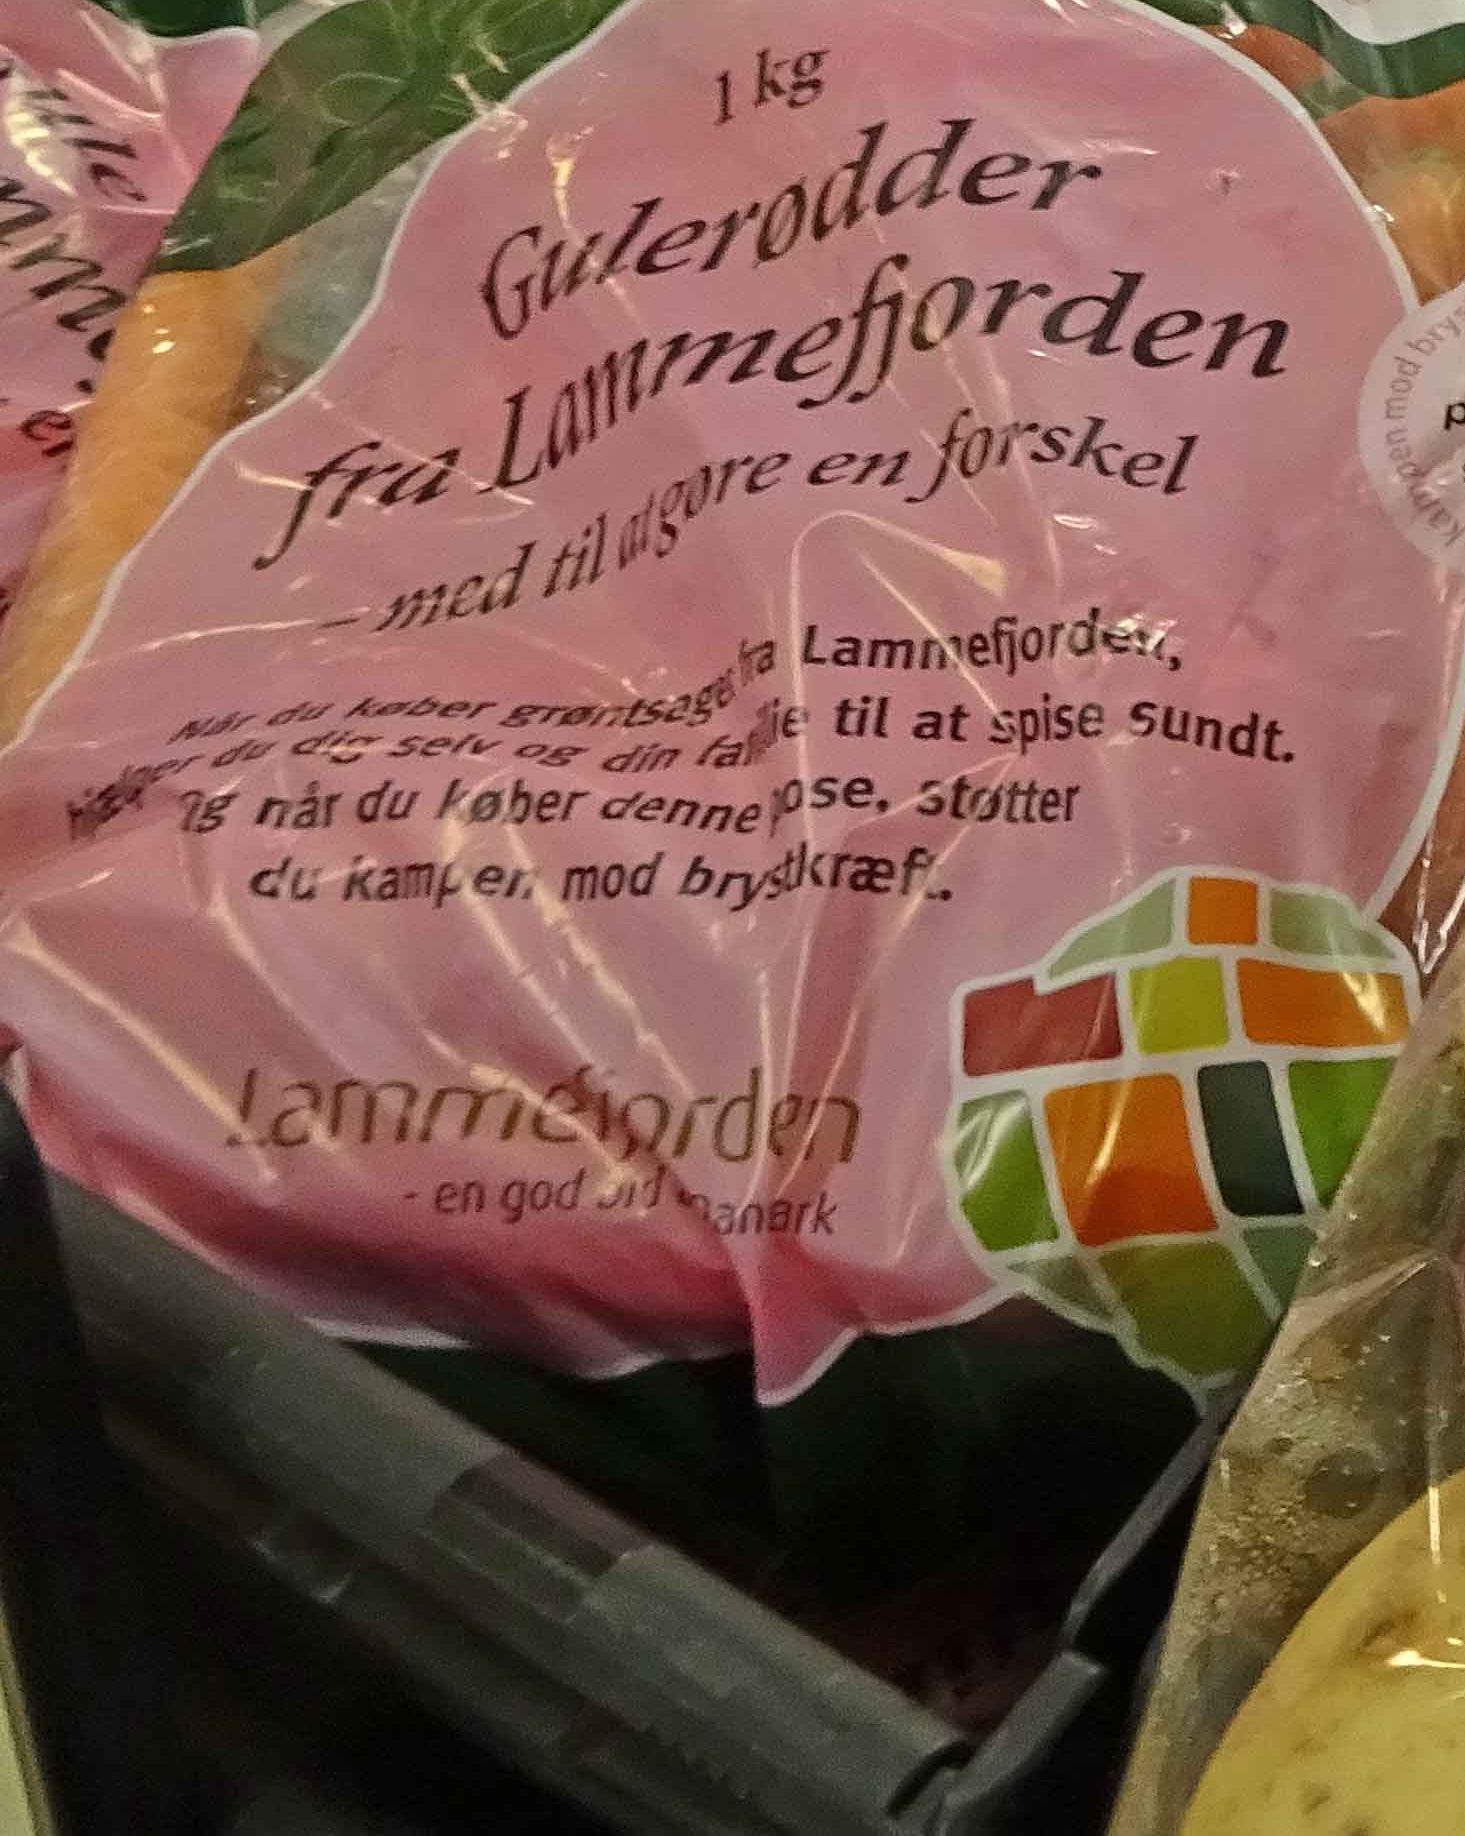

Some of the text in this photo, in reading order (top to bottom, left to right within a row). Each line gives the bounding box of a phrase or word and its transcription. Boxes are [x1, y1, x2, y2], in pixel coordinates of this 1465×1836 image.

[713, 46, 830, 126] 1 kg
[478, 117, 1104, 341] Gulerødder
[255, 253, 1291, 569] fra Lammefjorden
[371, 540, 551, 634] med
[542, 511, 609, 599] til
[806, 445, 914, 490] en
[904, 407, 1201, 506] forskel
[344, 693, 499, 725] køber
[388, 731, 504, 760] selv
[513, 741, 592, 769] og
[600, 742, 682, 773] din
[832, 694, 892, 740] til
[910, 701, 971, 743] at
[987, 690, 1106, 756] spise
[1126, 697, 1297, 766] sundt.
[255, 782, 343, 830] når
[355, 778, 422, 822] du
[435, 777, 591, 826] køber
[598, 787, 763, 836] denne
[915, 771, 1083, 826] støtter
[560, 852, 660, 903] mod
[434, 1177, 486, 1214] en
[497, 1168, 586, 1225] god
